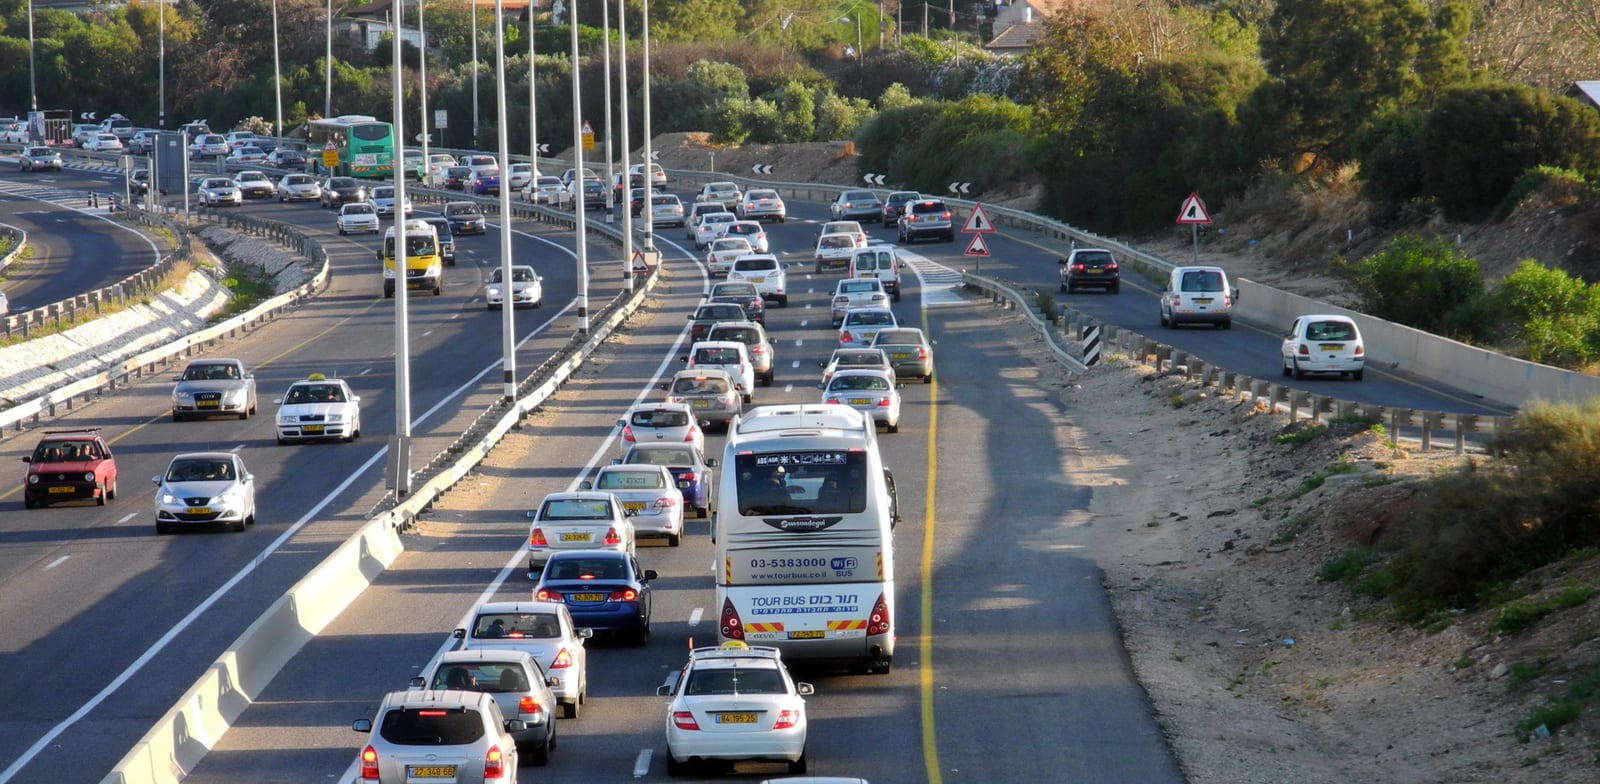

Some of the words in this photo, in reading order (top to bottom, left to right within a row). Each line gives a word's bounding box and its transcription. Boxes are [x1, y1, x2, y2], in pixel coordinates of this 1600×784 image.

[750, 558, 826, 568] 03-5383000
[751, 570, 827, 579] www.tourbus.co.il
[751, 596, 781, 606] TOUR
[783, 595, 806, 605] BUS
[835, 594, 858, 604] תור
